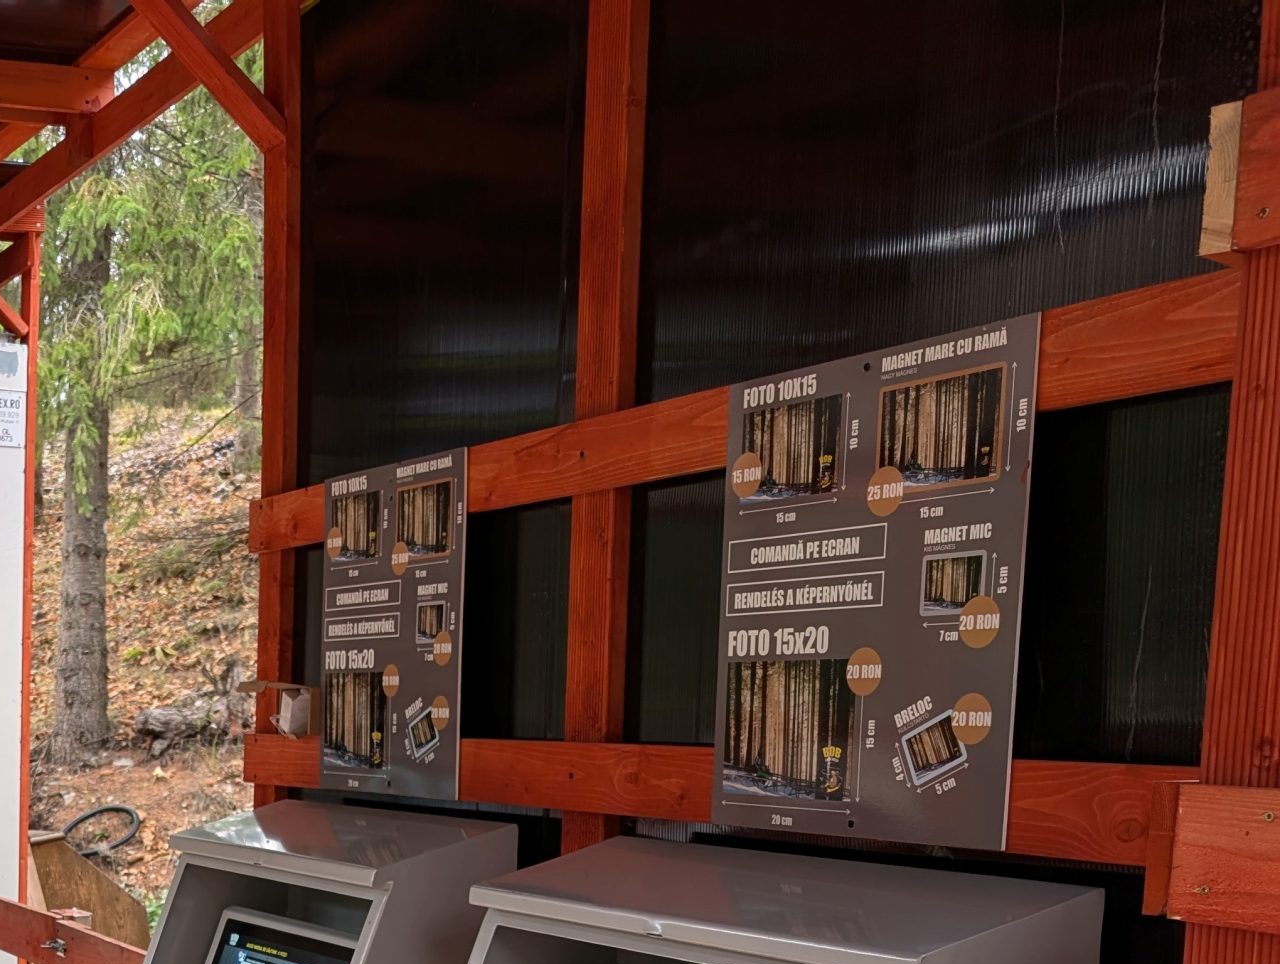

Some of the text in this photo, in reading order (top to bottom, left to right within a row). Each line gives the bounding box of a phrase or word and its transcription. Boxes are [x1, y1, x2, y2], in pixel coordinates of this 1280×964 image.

[881, 326, 1008, 372] MAGNET MARE CU RAMĂ
[743, 373, 818, 409] FOTO 10X15
[1016, 398, 1028, 432] 10 cm
[849, 418, 860, 450] 10 cm
[396, 464, 415, 478] MAGNET
[430, 459, 437, 471] CU
[732, 466, 762, 484] 15 RON
[332, 475, 368, 496] FOTO 10X15
[868, 481, 904, 500] 25 RON
[776, 512, 796, 524] 15 cm
[920, 505, 944, 519] 15 cm
[924, 522, 992, 544] MAGNET MIC
[392, 554, 398, 565] 25
[750, 536, 860, 565] COMANDĂ PE ECRAN
[417, 582, 448, 596] MAGNET MIC
[996, 566, 1008, 594] 5 cm
[336, 588, 389, 606] COMANDĂ PE ECRAN
[734, 580, 874, 610] RENDELÉS A KÉPERNYŐNÉL
[353, 623, 358, 635] A
[959, 613, 1000, 630] 20 RON
[727, 625, 829, 657] FOTO 15x20
[939, 630, 958, 642] 7 cm
[433, 642, 452, 655] 20 RON
[325, 649, 374, 670] FOTO 15x20
[846, 664, 882, 680] 20 RON
[404, 696, 423, 720] BRELOC
[431, 707, 450, 718] 20 RON
[894, 696, 932, 728] BRELOC
[952, 711, 992, 727] 20 RON
[866, 720, 876, 749] 15 cm
[822, 746, 842, 758] BOB
[892, 756, 904, 781] 4 cm
[934, 778, 956, 794] 5 cm
[772, 814, 793, 827] 20 cm
